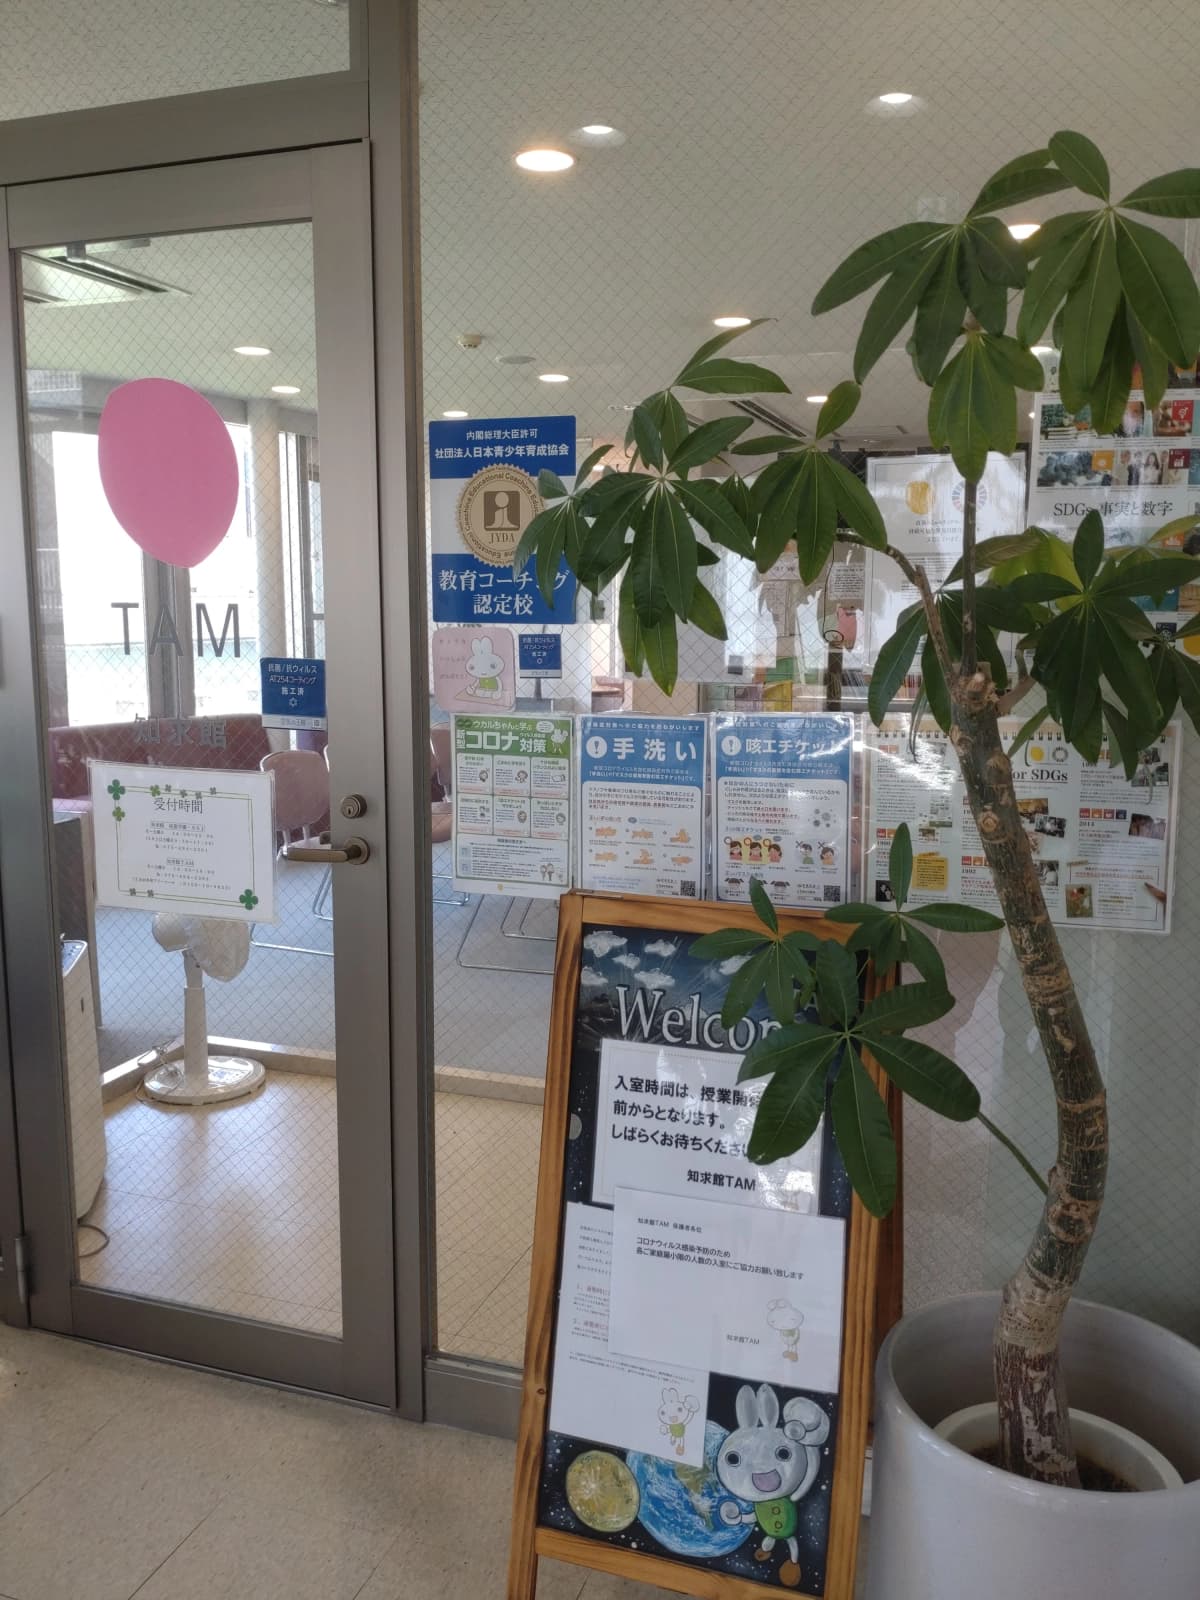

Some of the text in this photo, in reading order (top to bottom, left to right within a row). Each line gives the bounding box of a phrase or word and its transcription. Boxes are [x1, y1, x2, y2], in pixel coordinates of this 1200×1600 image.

[466, 428, 538, 440] 内閣総理大臣許可
[435, 444, 569, 459] 社団法人日本青少年育成協会
[438, 569, 570, 592] 教育コーチグ
[472, 593, 534, 615] 認定校
[110, 602, 241, 658] TAM
[466, 731, 520, 752] コロナ
[519, 739, 547, 753] 対策
[612, 737, 697, 761] 手洗い
[1013, 768, 1068, 781] or SDGs
[153, 797, 203, 814] 受付時間
[613, 1100, 725, 1129] 前からとなります。
[687, 1169, 757, 1191] 知求館TAM
[636, 1236, 731, 1258] コロナウィルス感染予防のため
